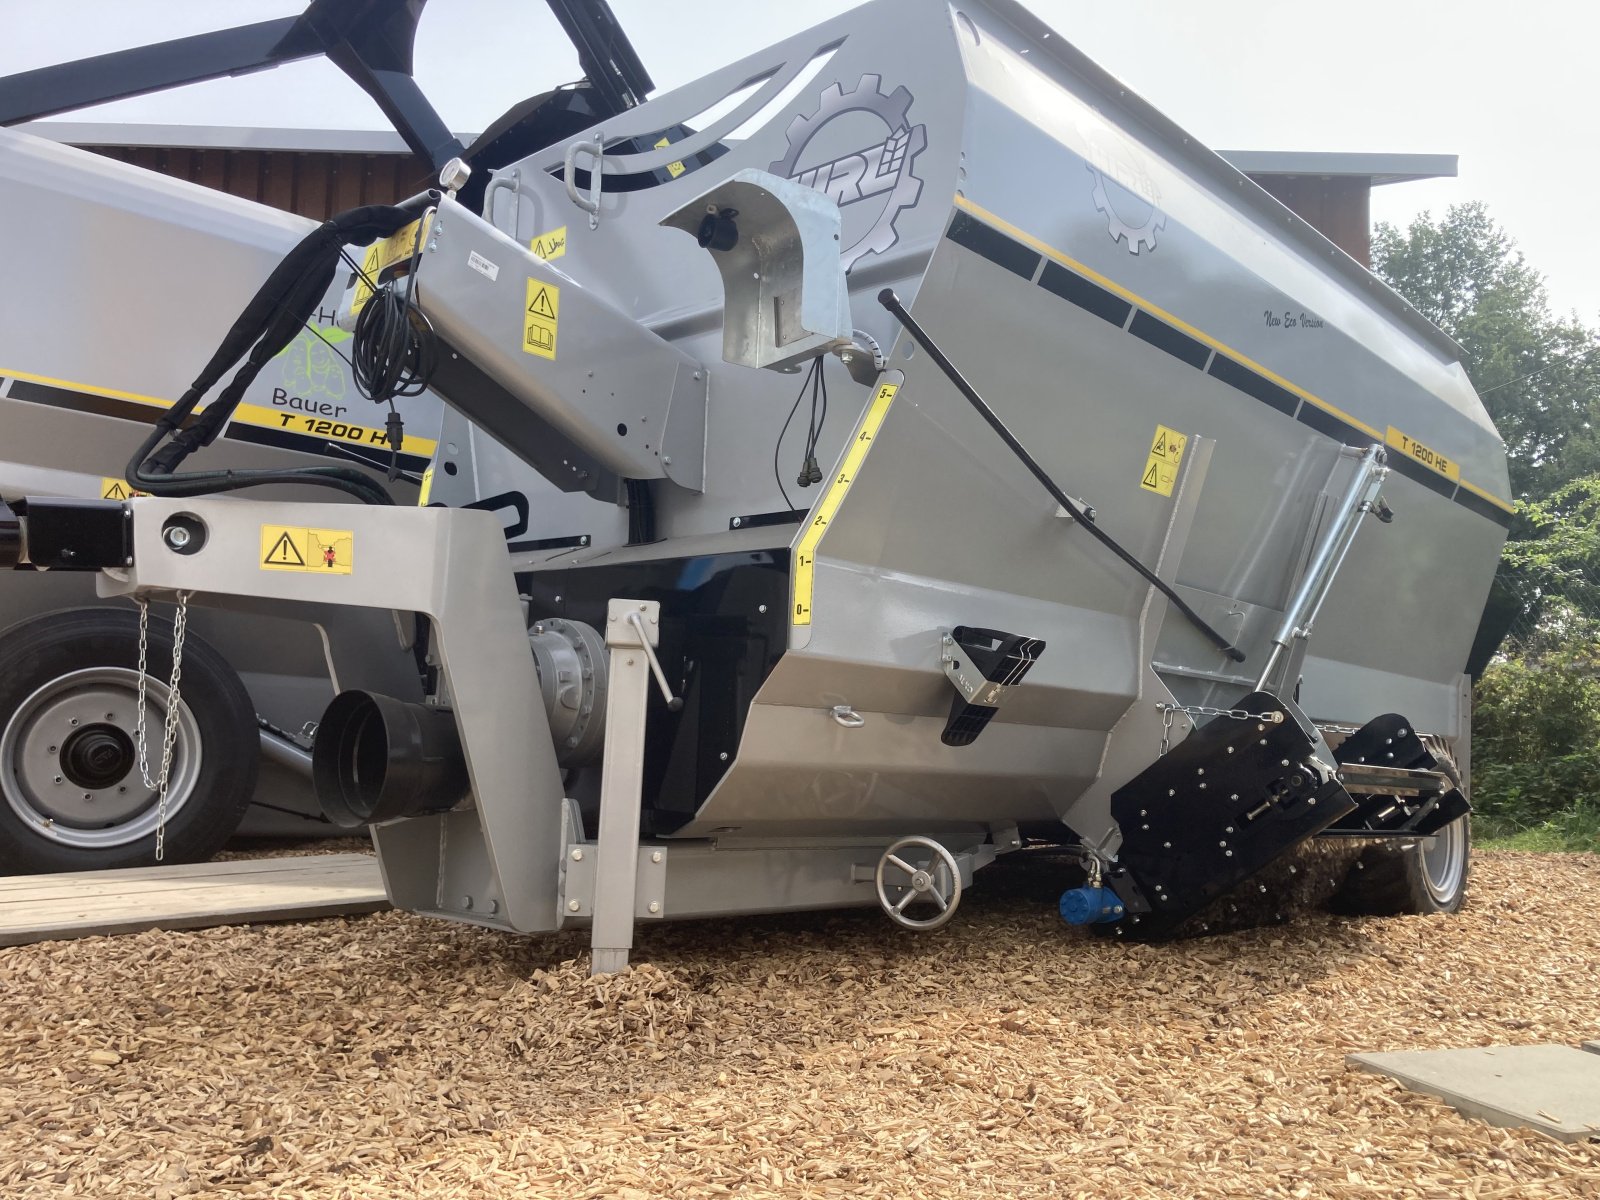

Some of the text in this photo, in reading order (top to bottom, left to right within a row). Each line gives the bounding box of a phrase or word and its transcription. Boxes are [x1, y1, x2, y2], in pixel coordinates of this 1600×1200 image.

[1263, 309, 1325, 329] New Eco Version
[271, 387, 348, 418] Bauer
[280, 413, 296, 427] T
[304, 418, 364, 441] 1200
[1402, 435, 1448, 473] T 1200 HE
